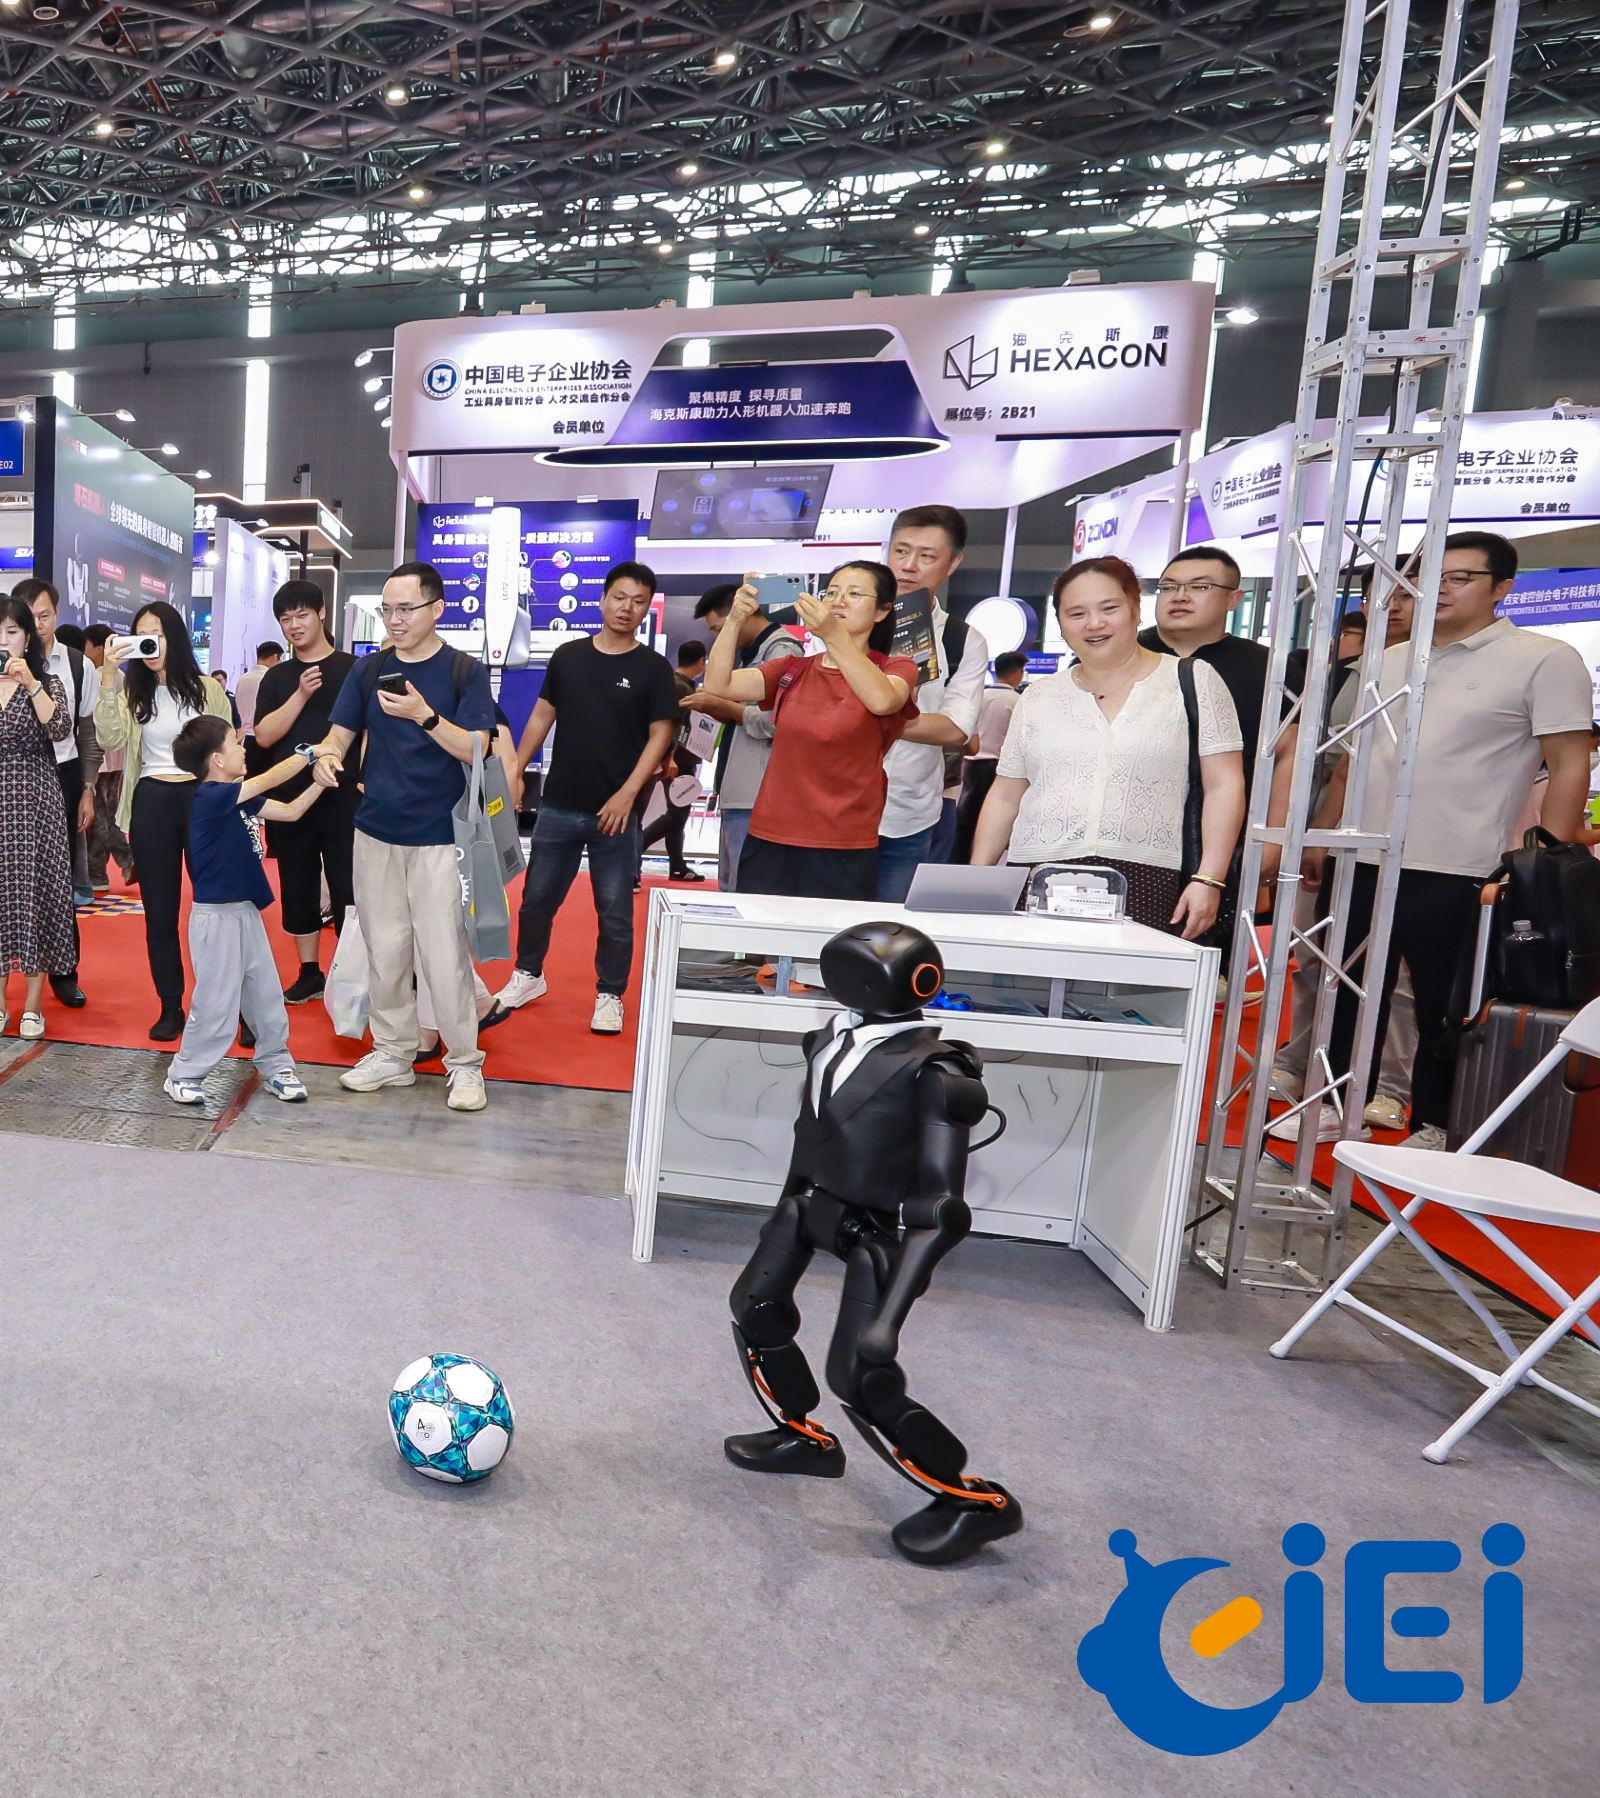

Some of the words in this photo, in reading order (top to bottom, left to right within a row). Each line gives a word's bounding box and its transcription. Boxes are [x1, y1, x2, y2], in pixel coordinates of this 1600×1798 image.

[1010, 342, 1168, 373] HEXACON
[465, 358, 632, 386] 中国电子企业协会
[688, 390, 742, 405] 聚焦精度
[749, 388, 803, 402] 探寻质量
[650, 402, 851, 421] 海克斯康助力人形机器人加速奔跑
[1000, 406, 1036, 419] 2B21
[553, 420, 605, 434] 会员单位
[1417, 448, 1578, 468] 中电子企业协会
[1521, 503, 1571, 514] 会员单位
